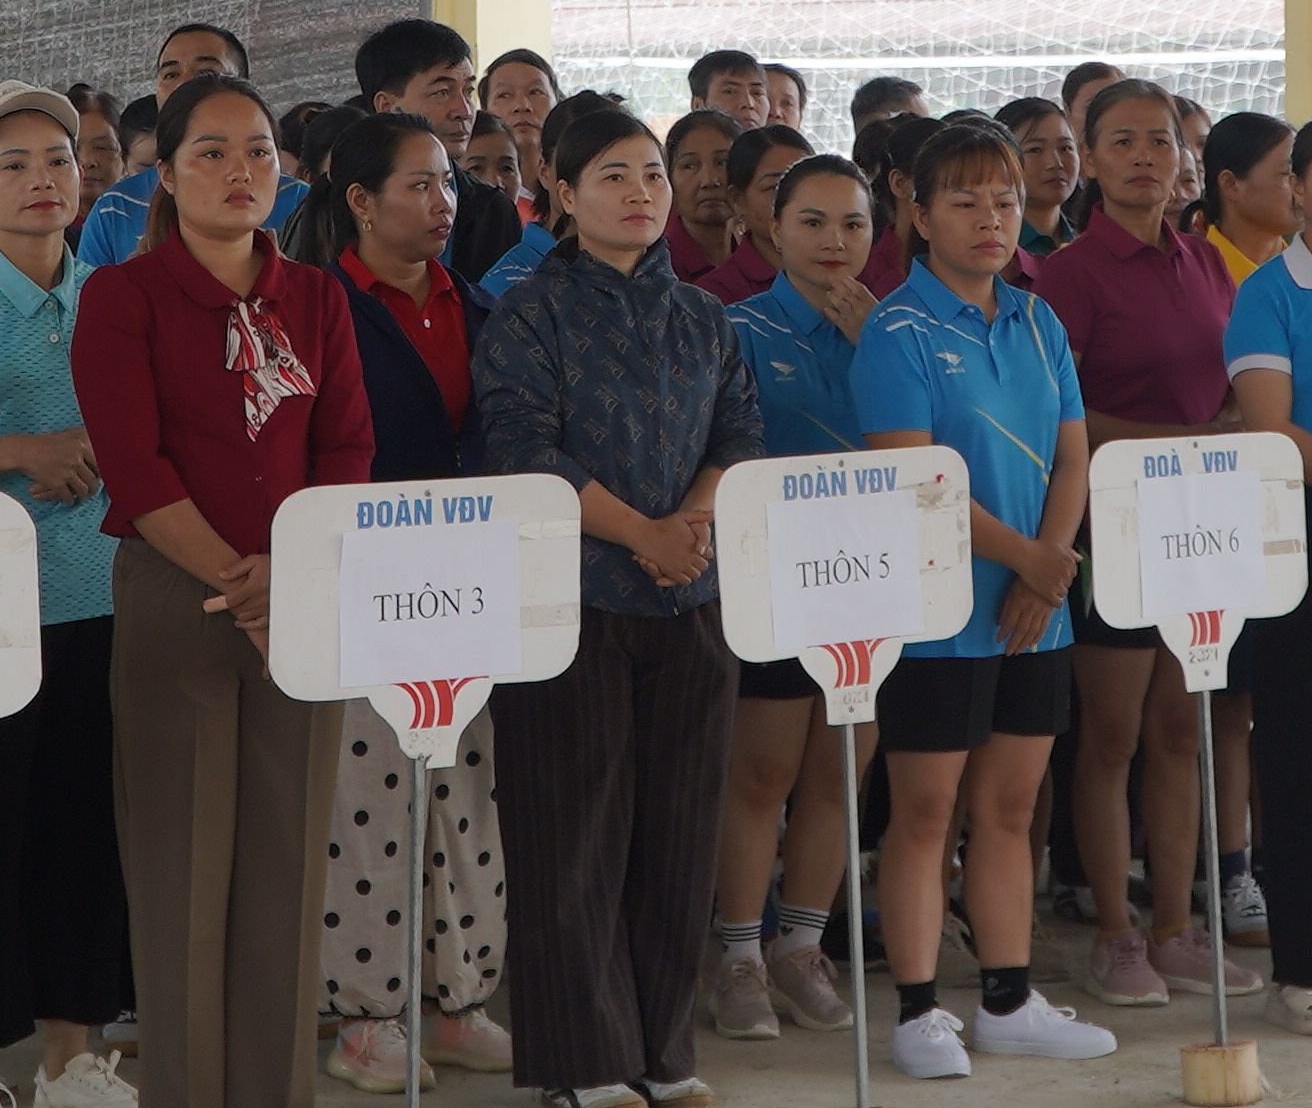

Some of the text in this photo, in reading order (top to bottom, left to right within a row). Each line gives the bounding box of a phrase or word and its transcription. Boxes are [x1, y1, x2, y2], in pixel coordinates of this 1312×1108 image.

[1202, 450, 1238, 474] VĐV
[782, 465, 897, 501] ĐOÀN VĐV
[355, 494, 494, 530] ĐOÀN VĐV
[1160, 523, 1240, 560] THÔN 6
[795, 549, 891, 589] THÔN 5
[372, 582, 485, 623] THÔN 3
